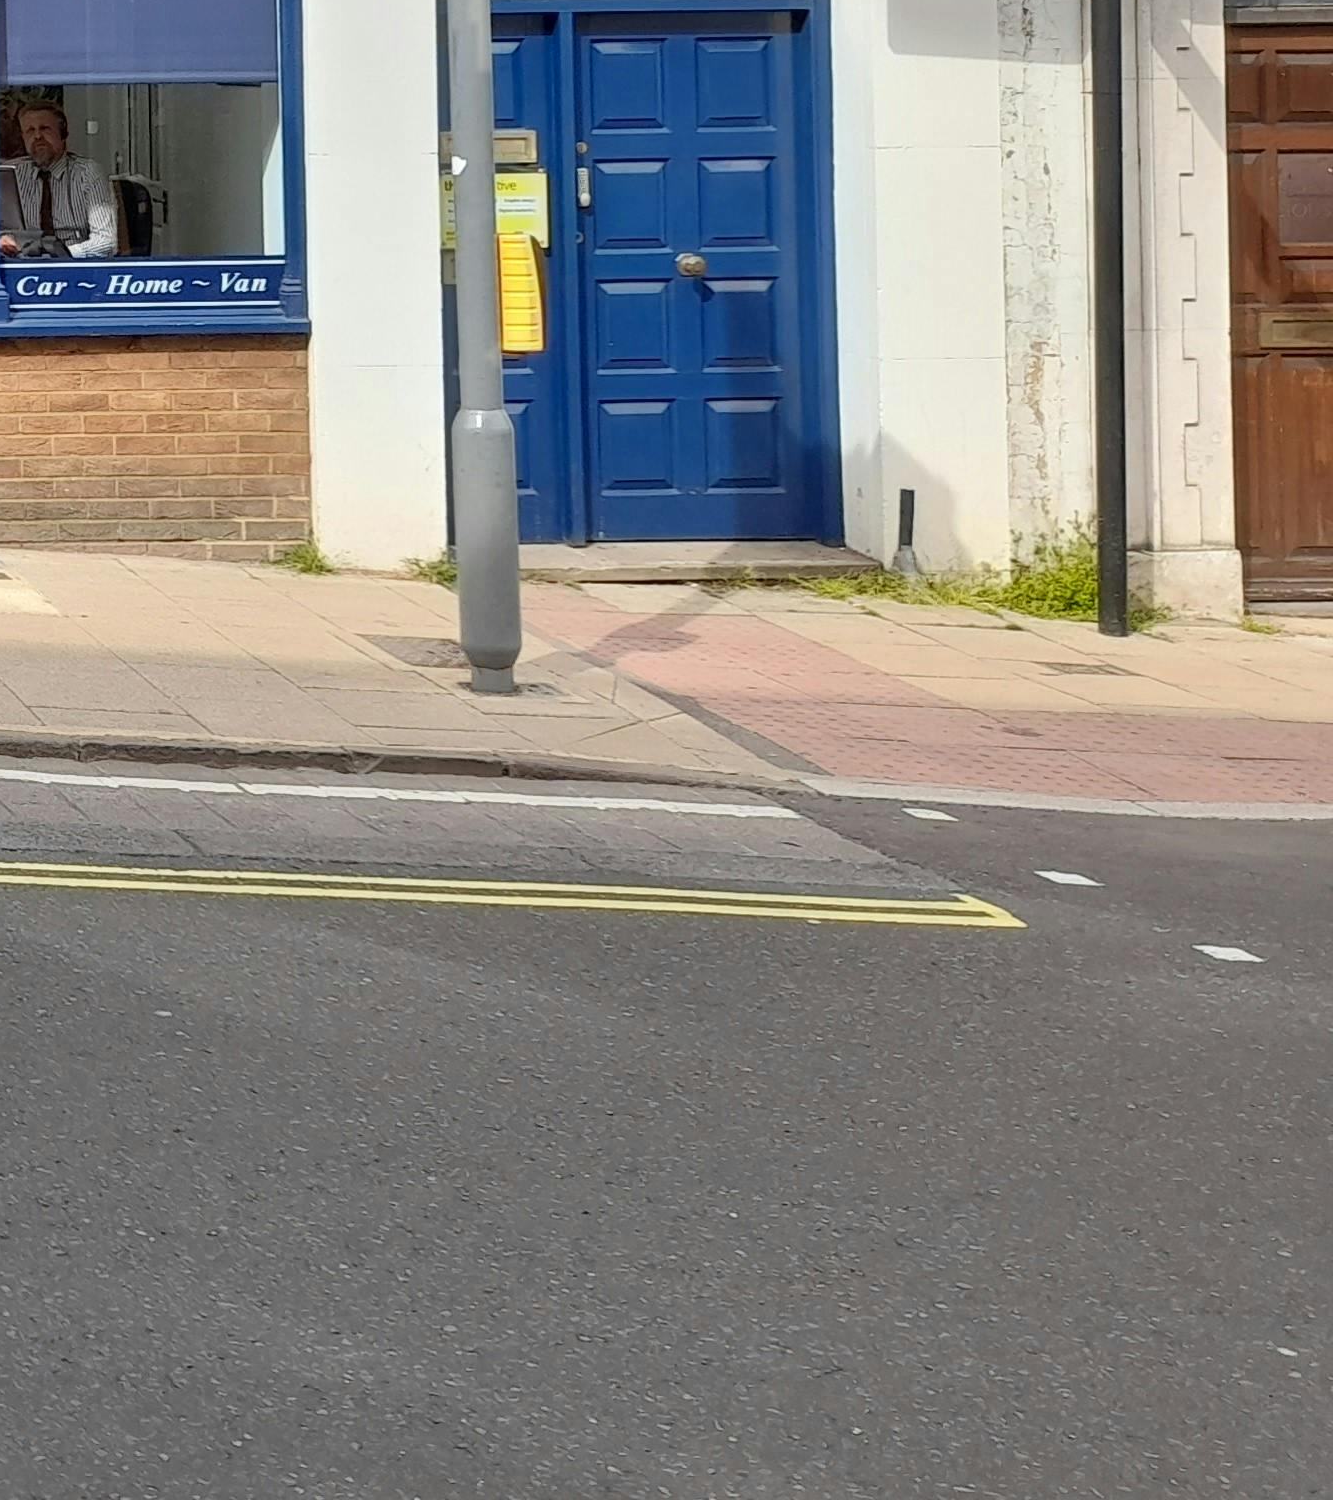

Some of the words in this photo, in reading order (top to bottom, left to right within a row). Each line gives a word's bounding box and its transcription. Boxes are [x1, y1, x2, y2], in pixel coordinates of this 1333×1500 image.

[16, 275, 69, 297] Car
[106, 273, 182, 296] Home
[220, 272, 268, 294] Van
